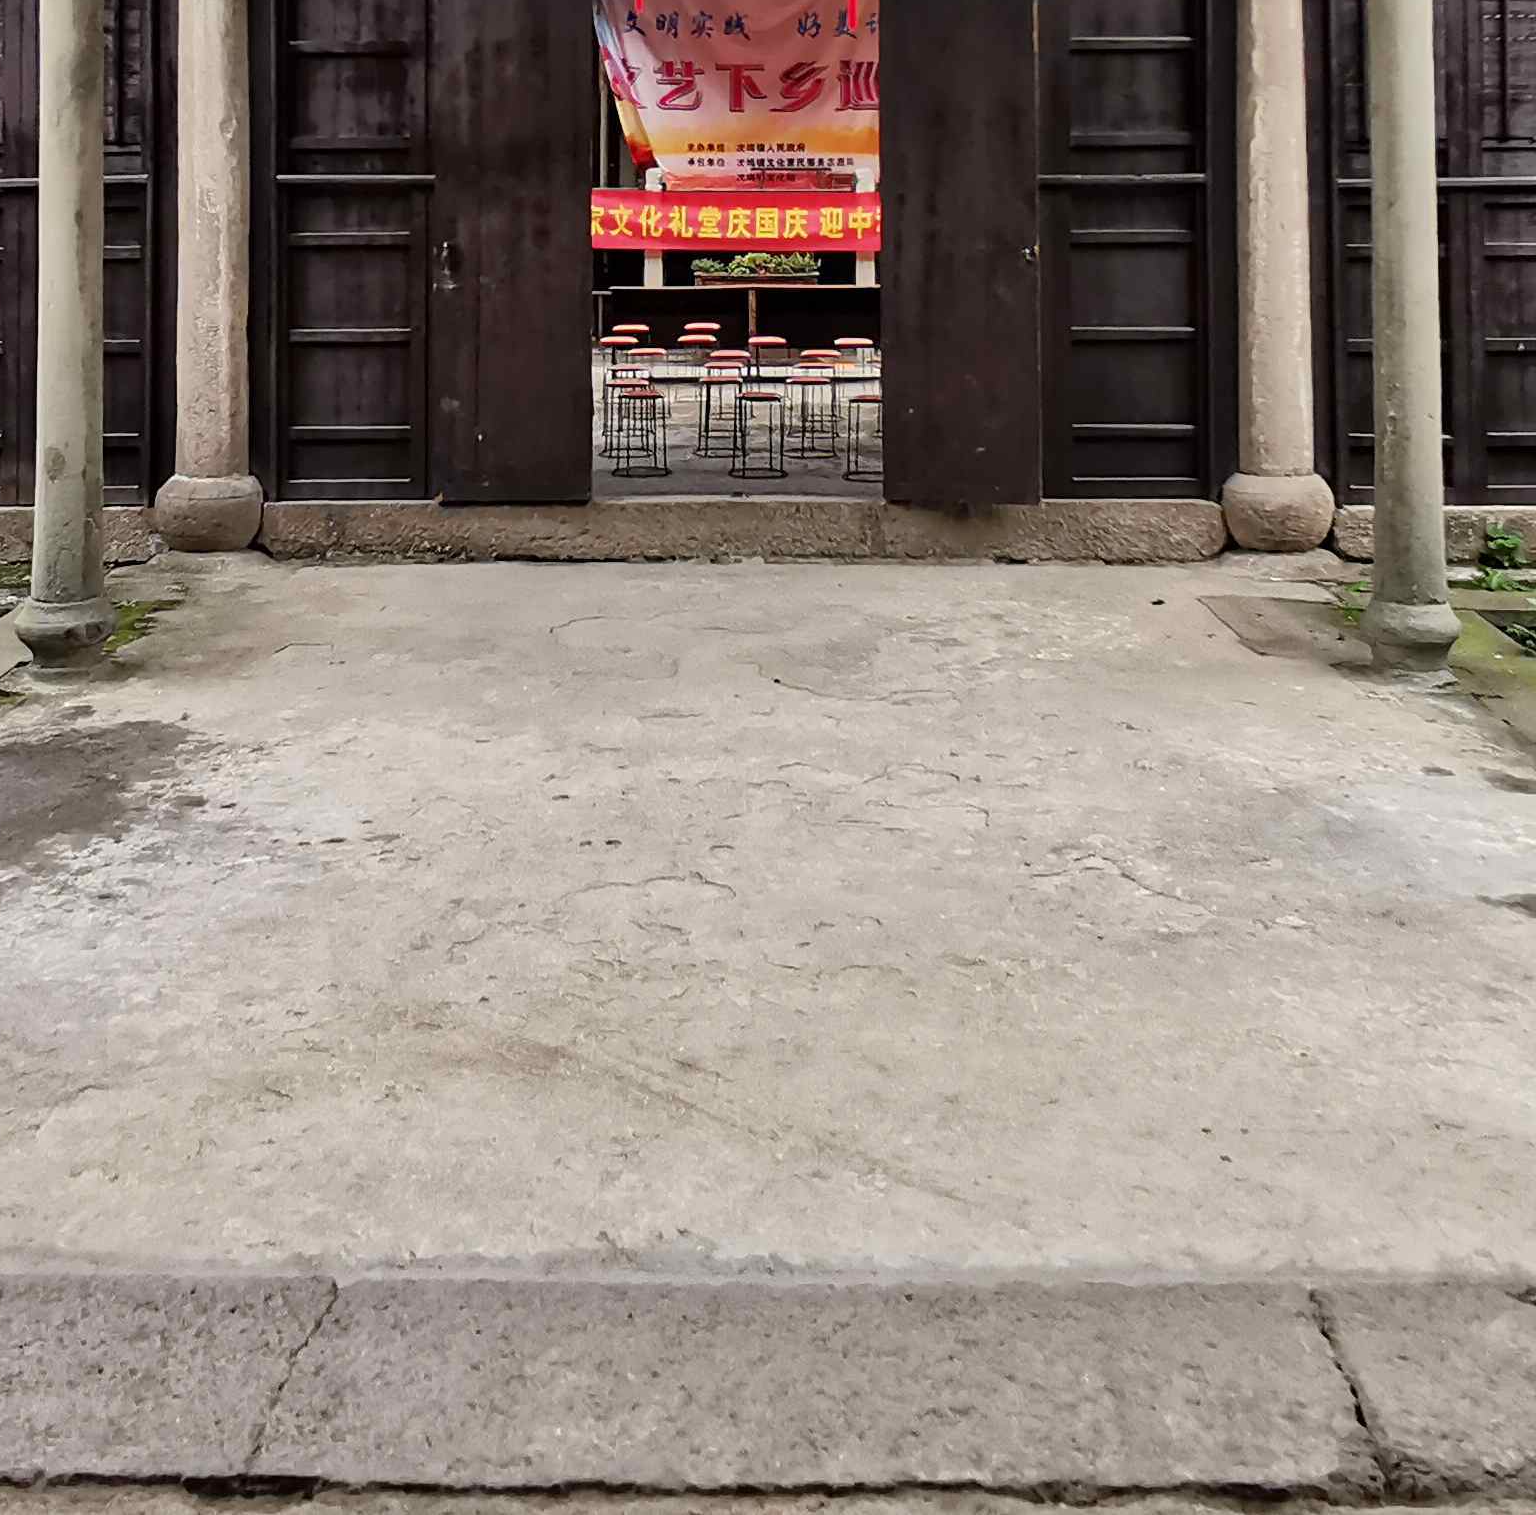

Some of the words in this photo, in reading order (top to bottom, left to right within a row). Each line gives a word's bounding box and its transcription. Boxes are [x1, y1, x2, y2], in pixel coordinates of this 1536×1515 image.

[624, 10, 751, 40] 文明实践
[819, 204, 881, 240] 迎中
